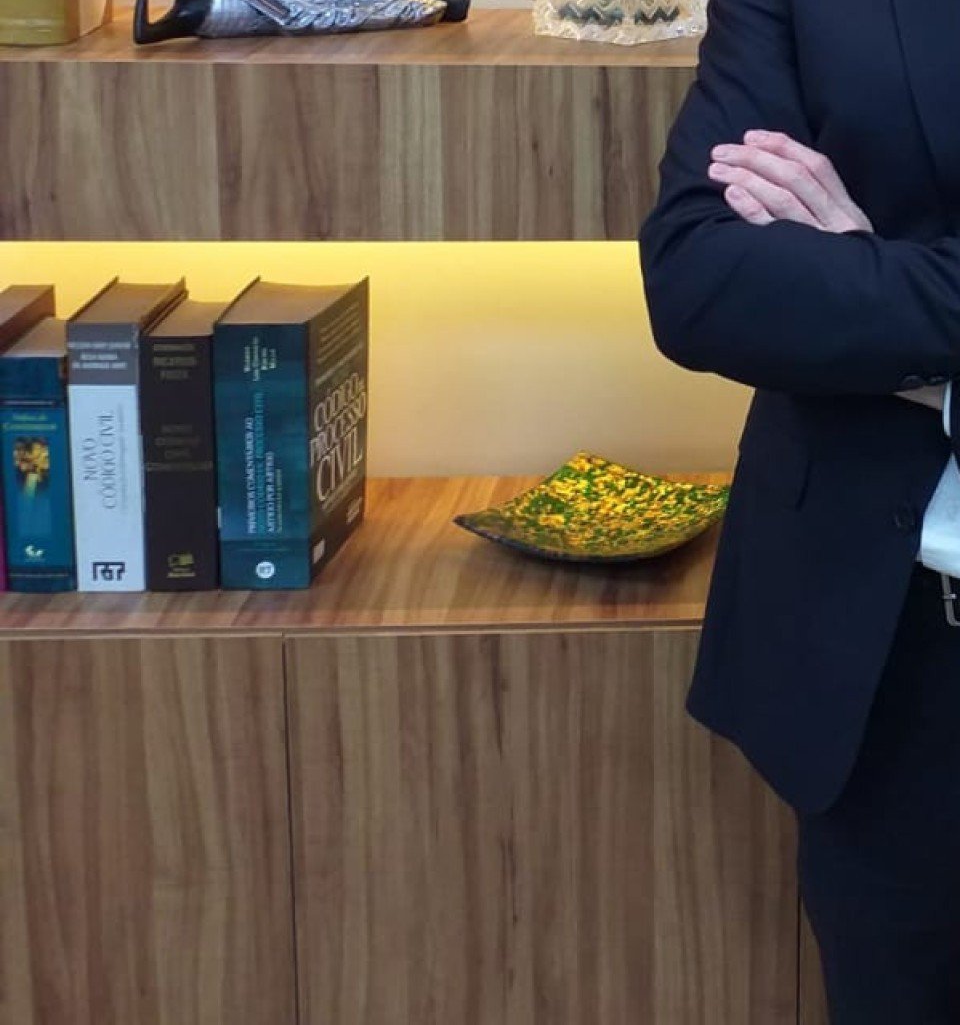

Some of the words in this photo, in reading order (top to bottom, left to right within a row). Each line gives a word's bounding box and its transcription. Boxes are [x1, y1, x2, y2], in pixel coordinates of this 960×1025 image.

[96, 410, 115, 448] CIVIL
[310, 391, 367, 468] PROCESSO
[82, 438, 98, 481] NOVO
[97, 449, 117, 509] CÓDIGO
[316, 428, 363, 504] CIVIL
